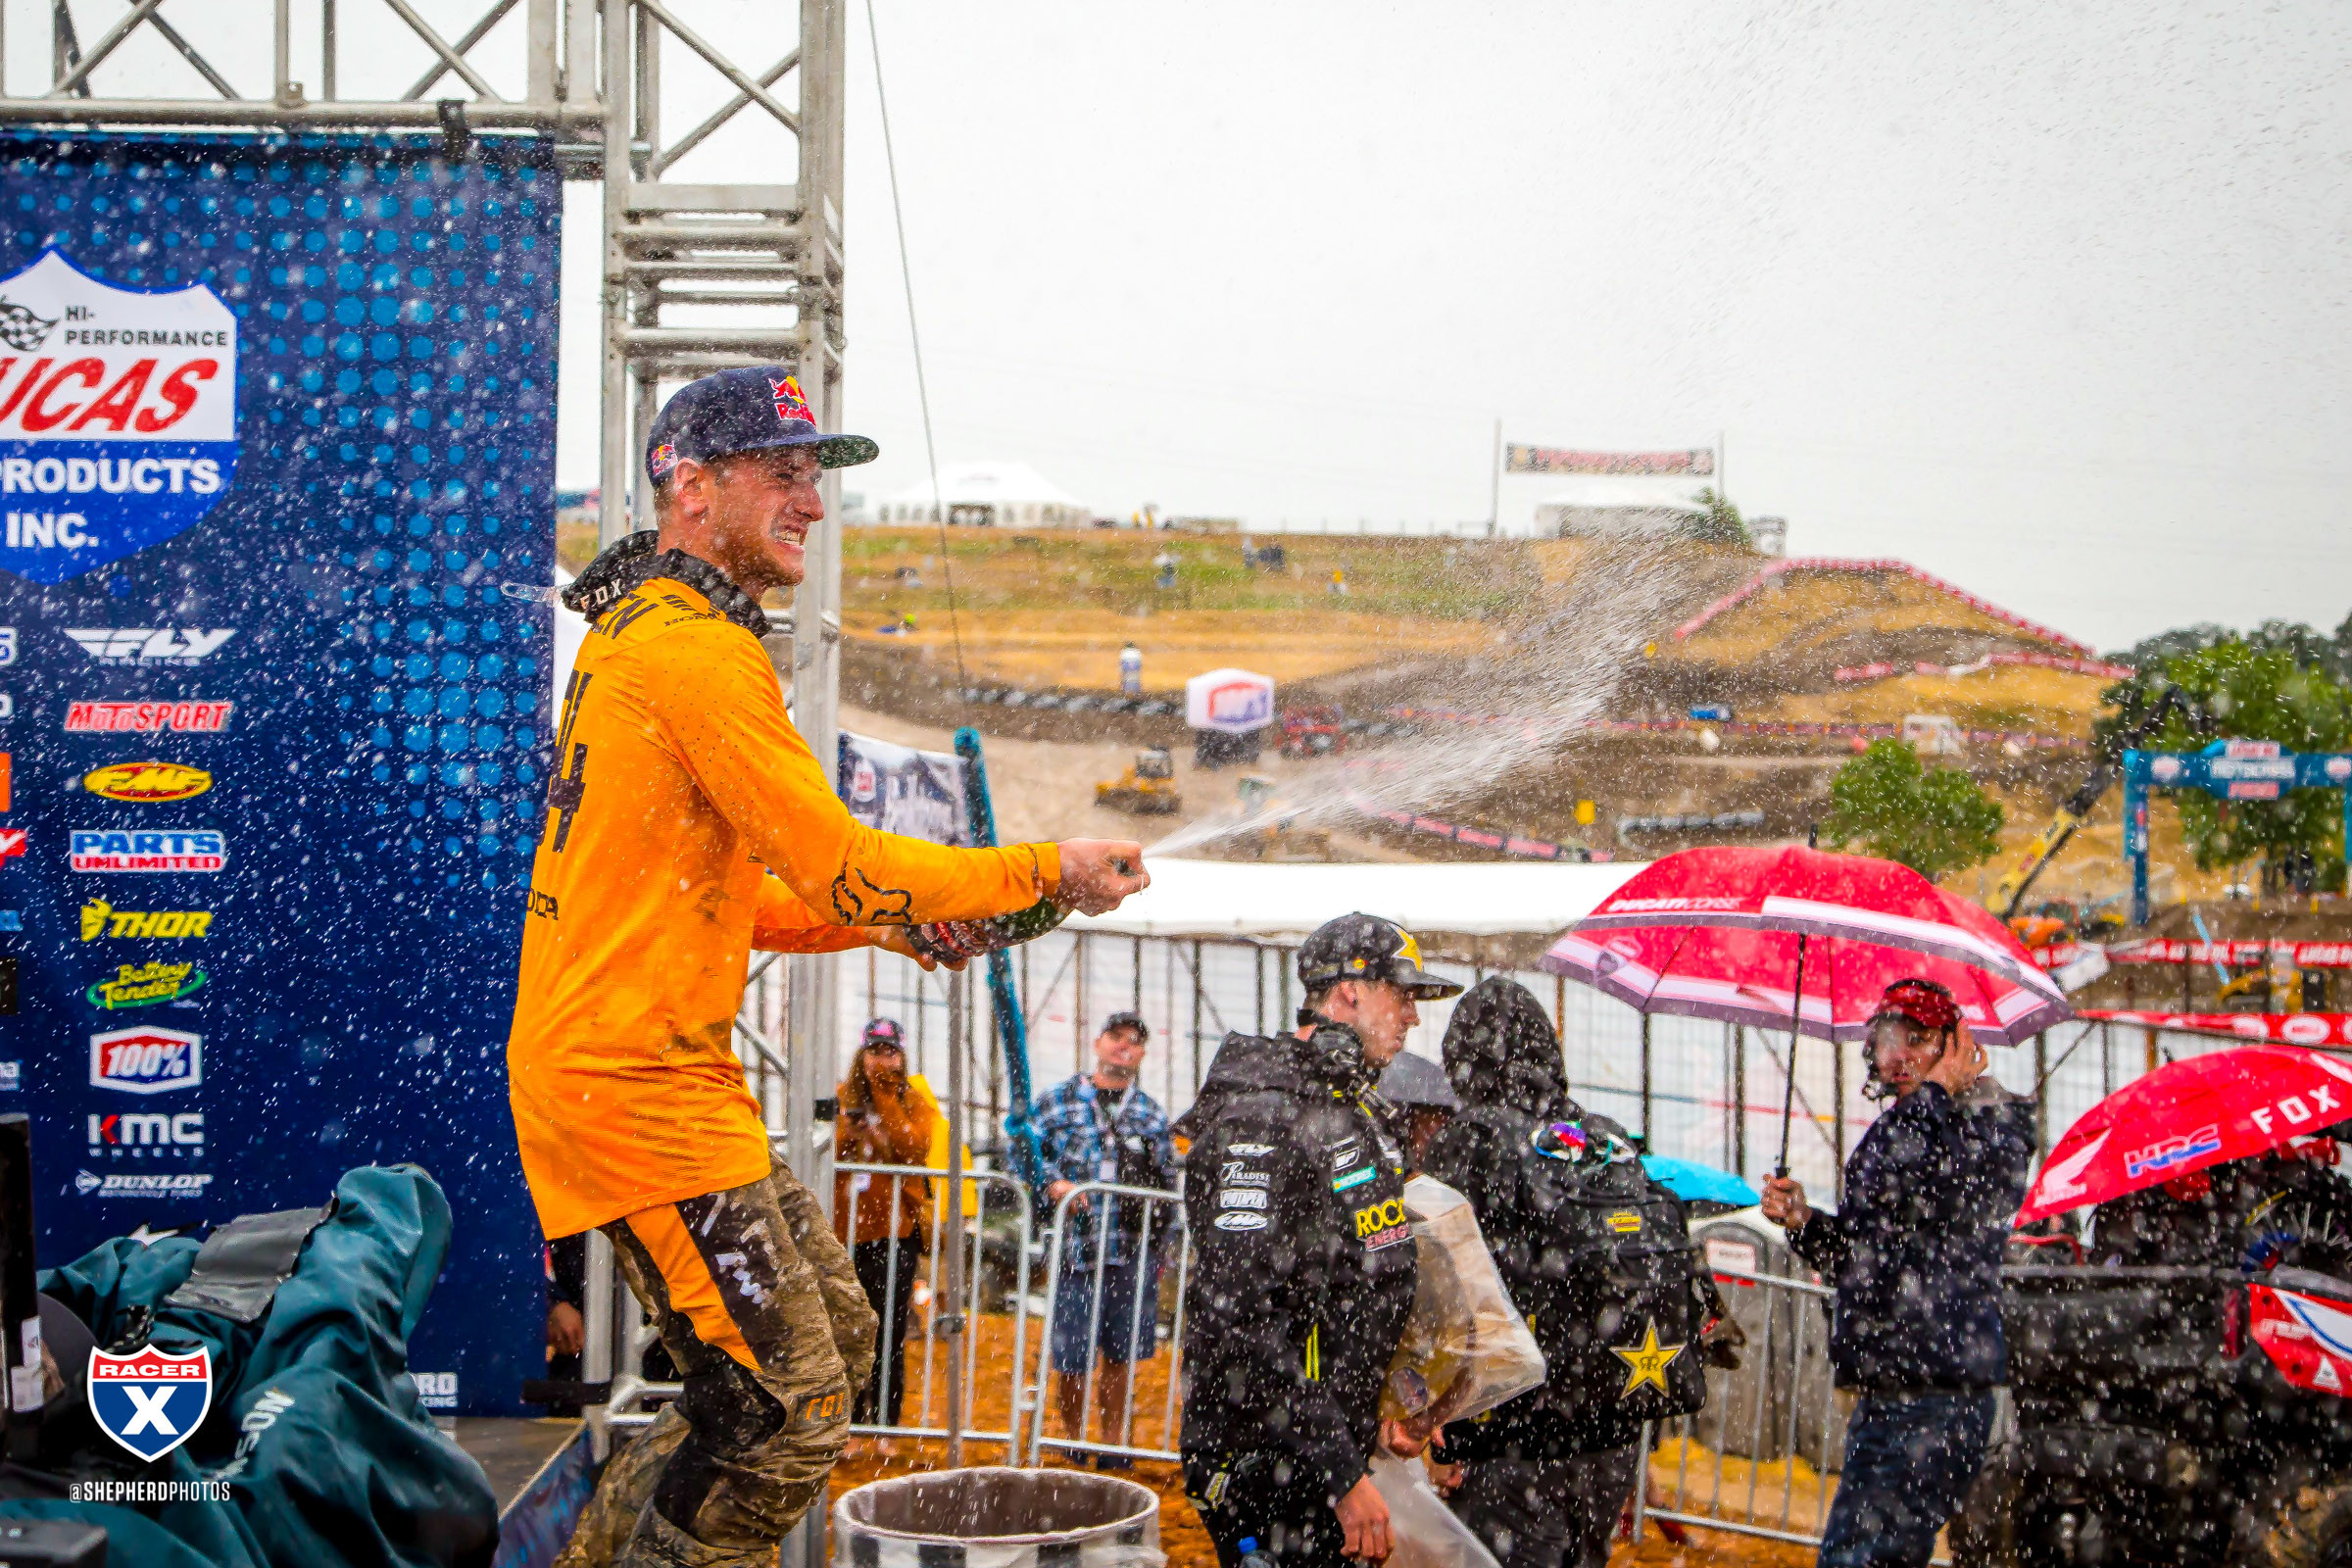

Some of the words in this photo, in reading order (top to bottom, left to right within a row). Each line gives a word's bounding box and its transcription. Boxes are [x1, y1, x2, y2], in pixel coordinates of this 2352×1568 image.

[66, 306, 96, 321] HI-
[65, 329, 228, 347] PERFORMANCE
[0, 357, 220, 434] UCAS
[0, 458, 220, 494] RODUCTS
[6, 513, 100, 549] INC.
[63, 628, 240, 657] FLY
[84, 768, 212, 792] FMF
[74, 833, 221, 854] PARTS
[74, 857, 222, 869] UNLIMITED
[1606, 898, 1686, 912] DUCATI
[107, 910, 214, 939] THOR
[105, 1042, 188, 1078] 100%
[2250, 1084, 2341, 1135] FOX
[87, 1113, 205, 1146] KMC
[101, 1174, 214, 1190] DUNLOP
[1366, 1222, 1409, 1250] ENERG
